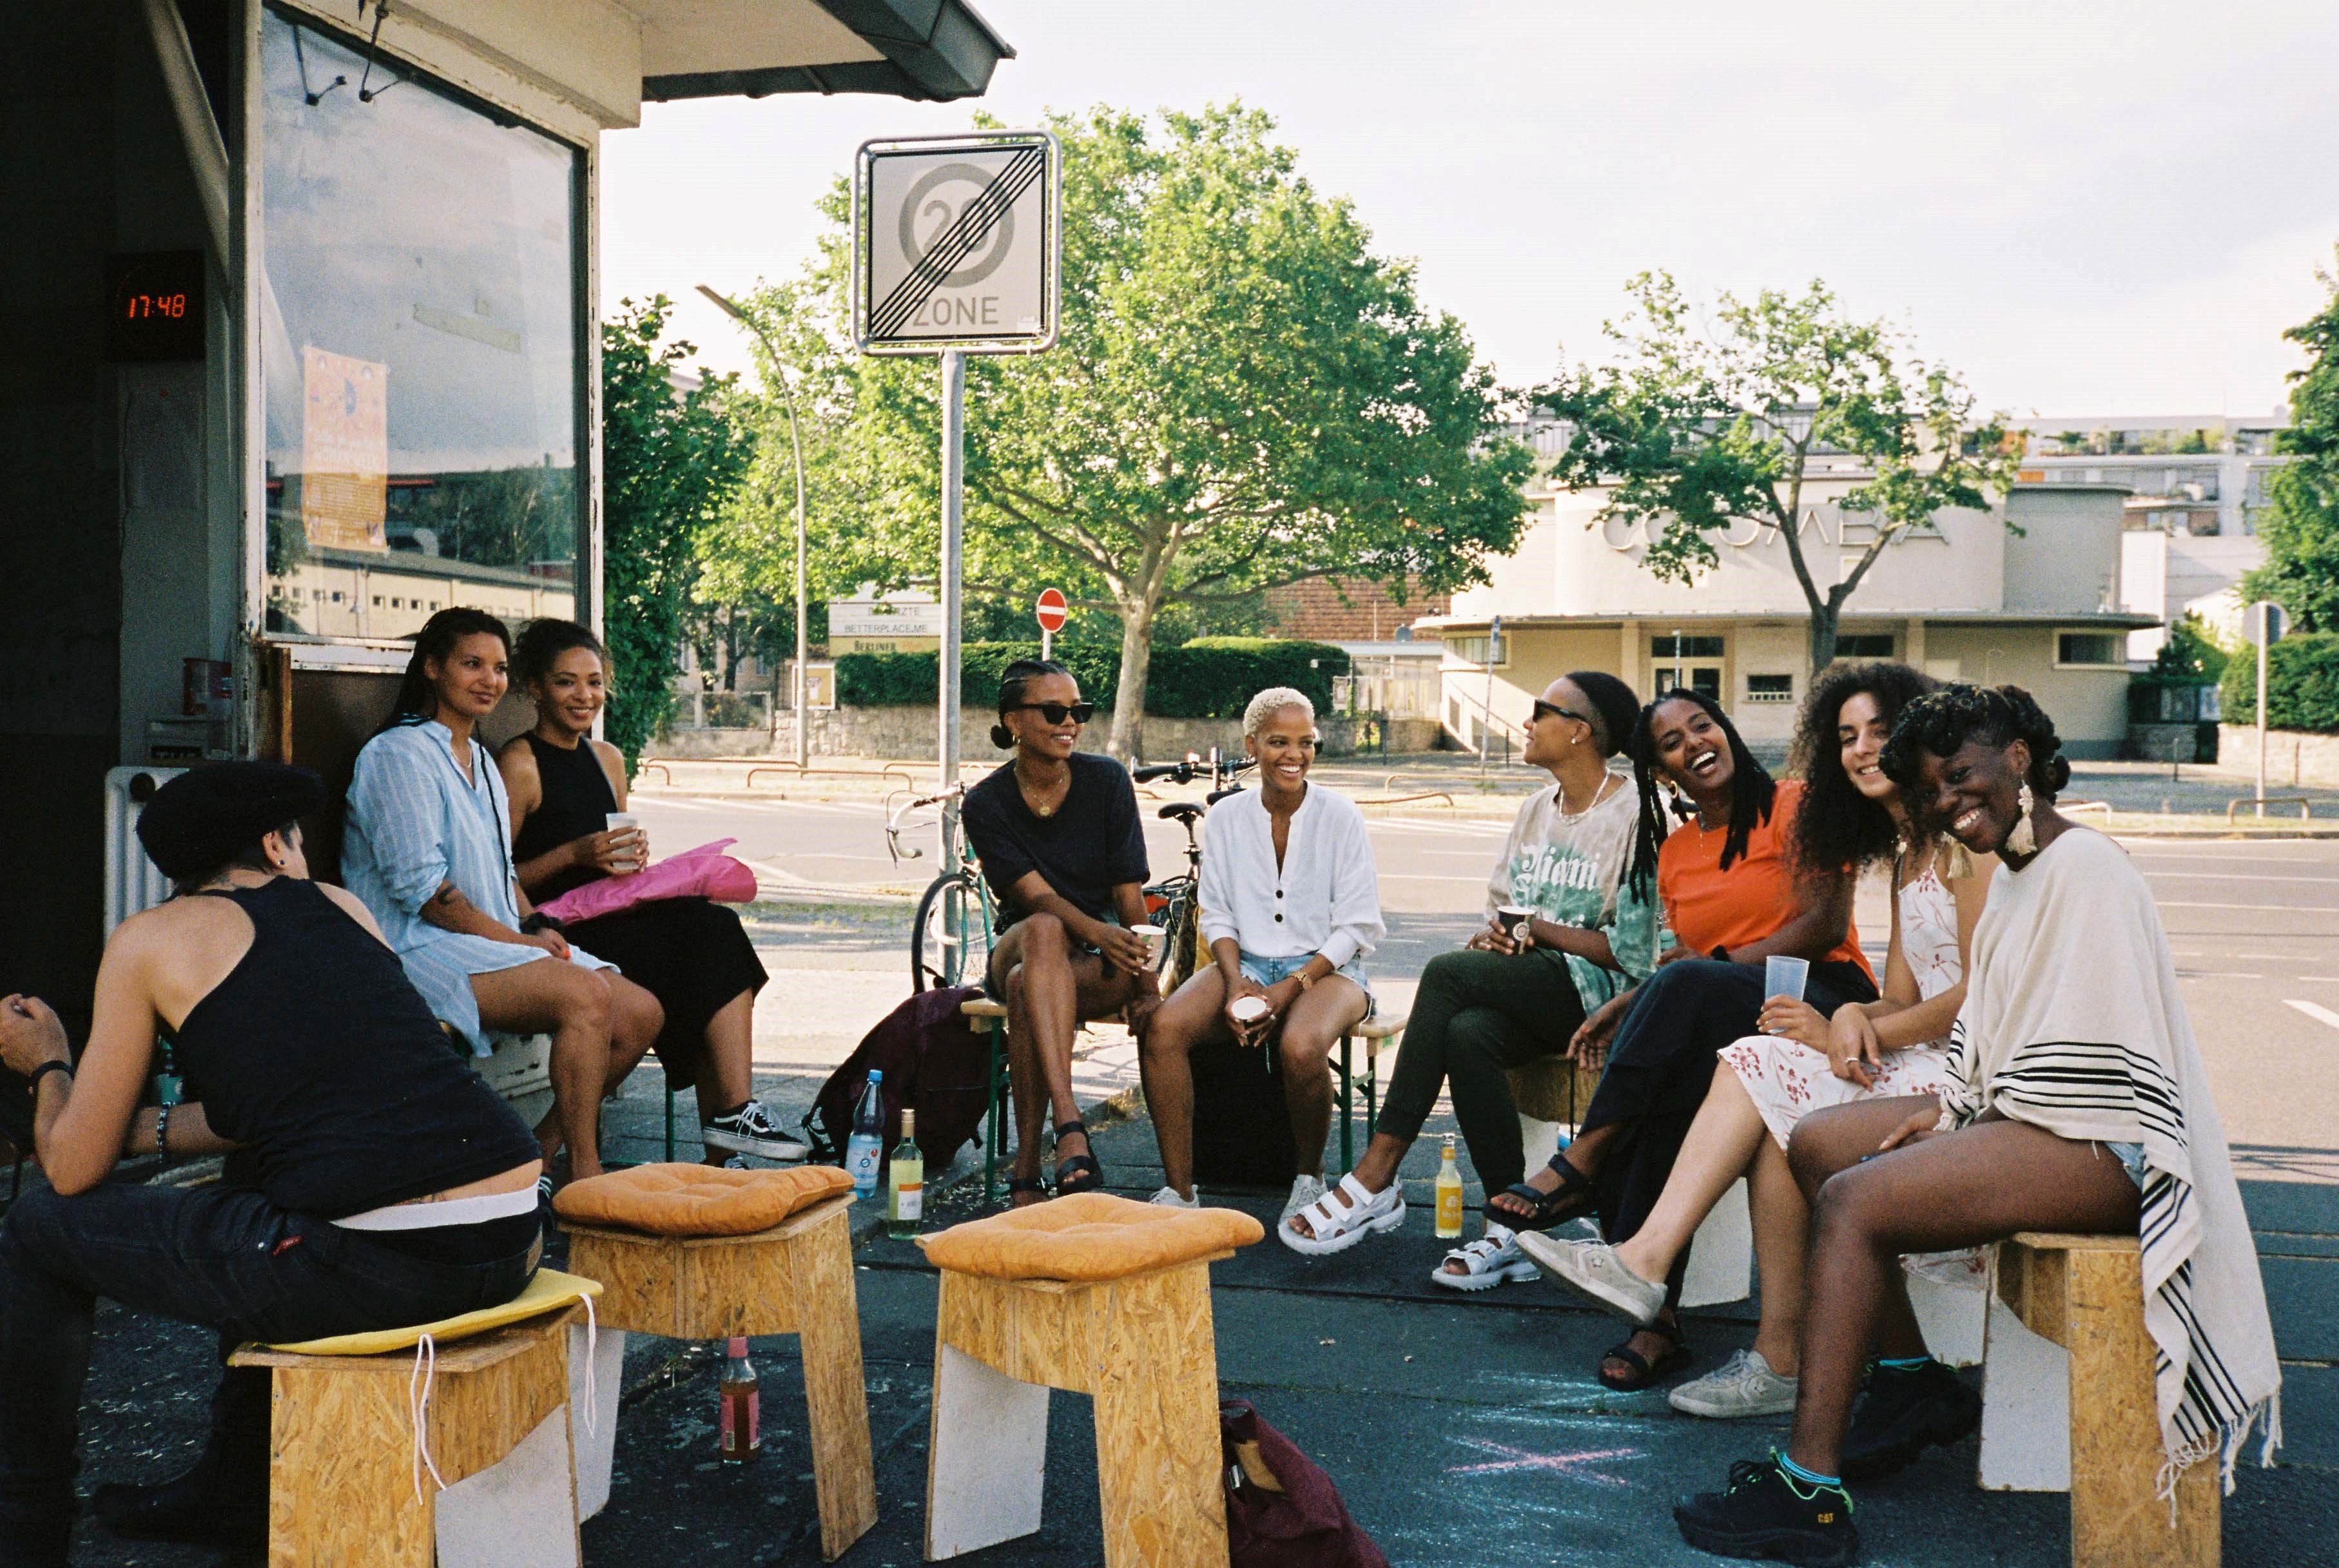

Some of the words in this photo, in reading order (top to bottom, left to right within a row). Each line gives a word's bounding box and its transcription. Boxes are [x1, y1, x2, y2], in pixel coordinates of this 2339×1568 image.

[923, 197, 989, 255] 20
[129, 294, 186, 318] 17:48
[912, 296, 1000, 327] ZONE
